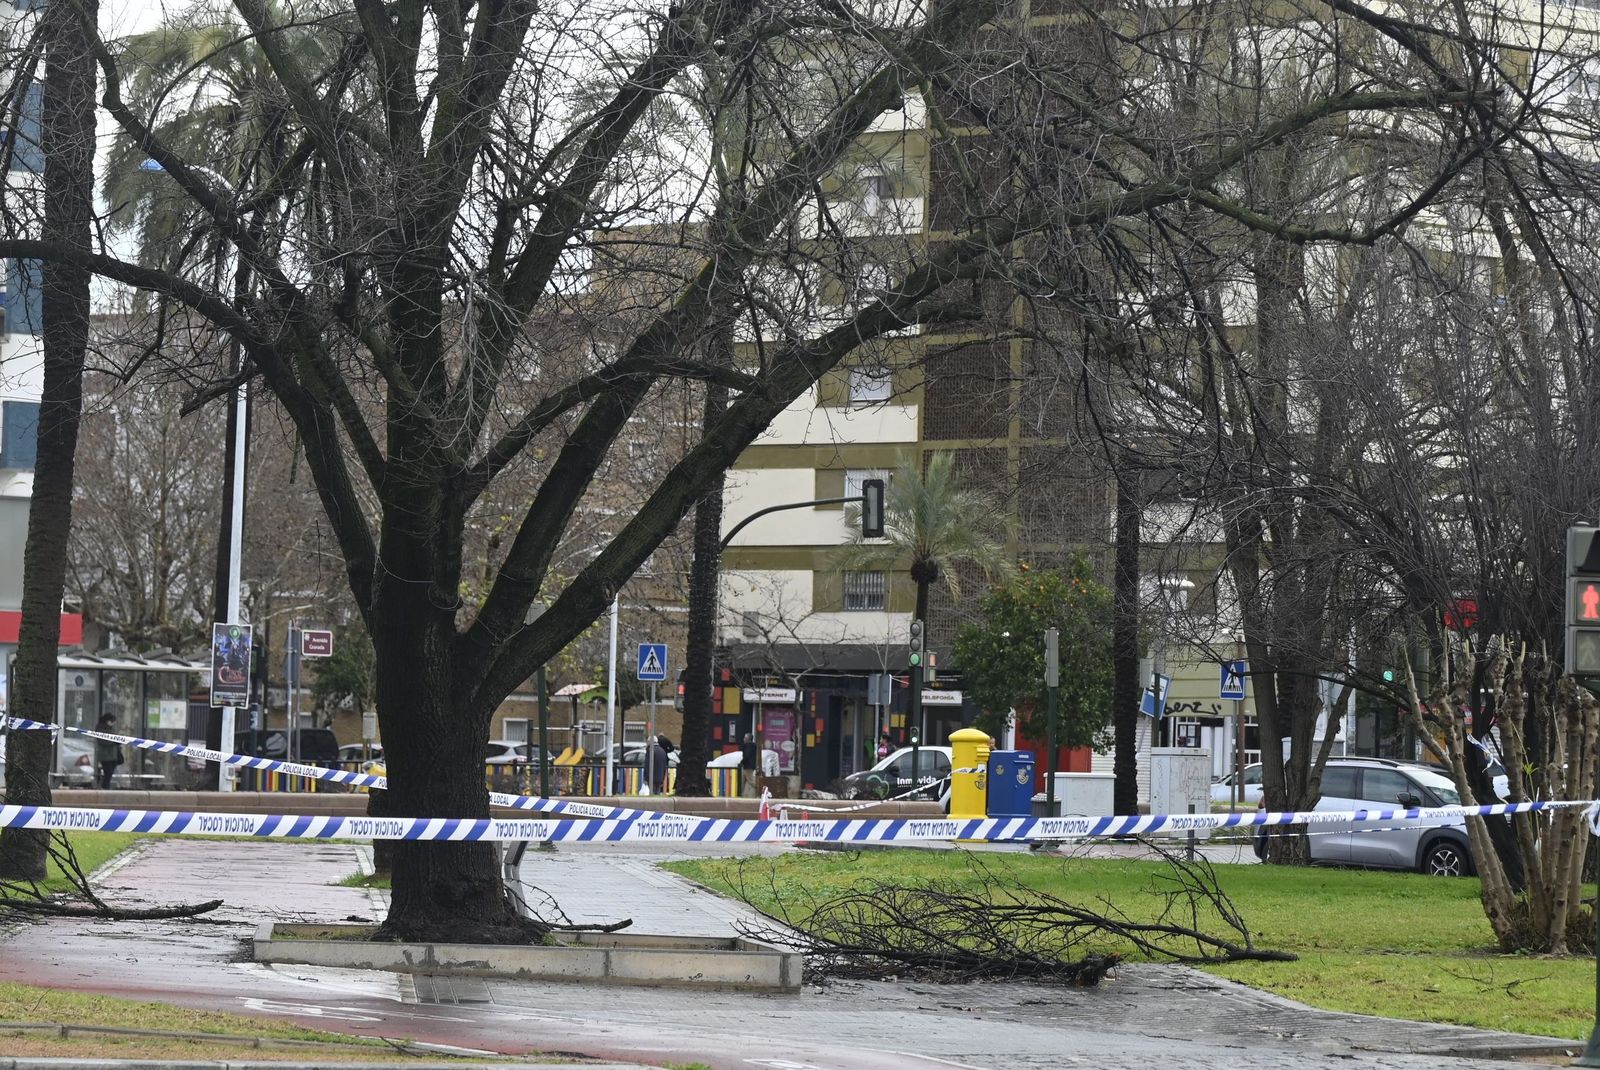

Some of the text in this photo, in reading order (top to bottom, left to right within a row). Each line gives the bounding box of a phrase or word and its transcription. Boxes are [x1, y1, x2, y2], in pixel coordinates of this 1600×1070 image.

[186, 748, 222, 761] POLICIA LOCAL
[282, 764, 318, 777] POLICIA LOCAL
[896, 776, 937, 785] Inmvida
[494, 796, 509, 805] LOCAL
[569, 804, 605, 816] POLICIA LOCAL
[43, 810, 100, 827] POLICIA LOCAL
[198, 816, 254, 833] POLICIA LOCAL
[349, 820, 403, 836] POLICIA LOCAL
[495, 822, 548, 838] POLICIA LOCAL
[637, 822, 688, 838] POLICIA LOCAL
[775, 823, 825, 837] POLICIA LOCAL
[909, 822, 958, 836] POLICIA LOCAL
[1041, 820, 1089, 834] POLICIA LOCAL
